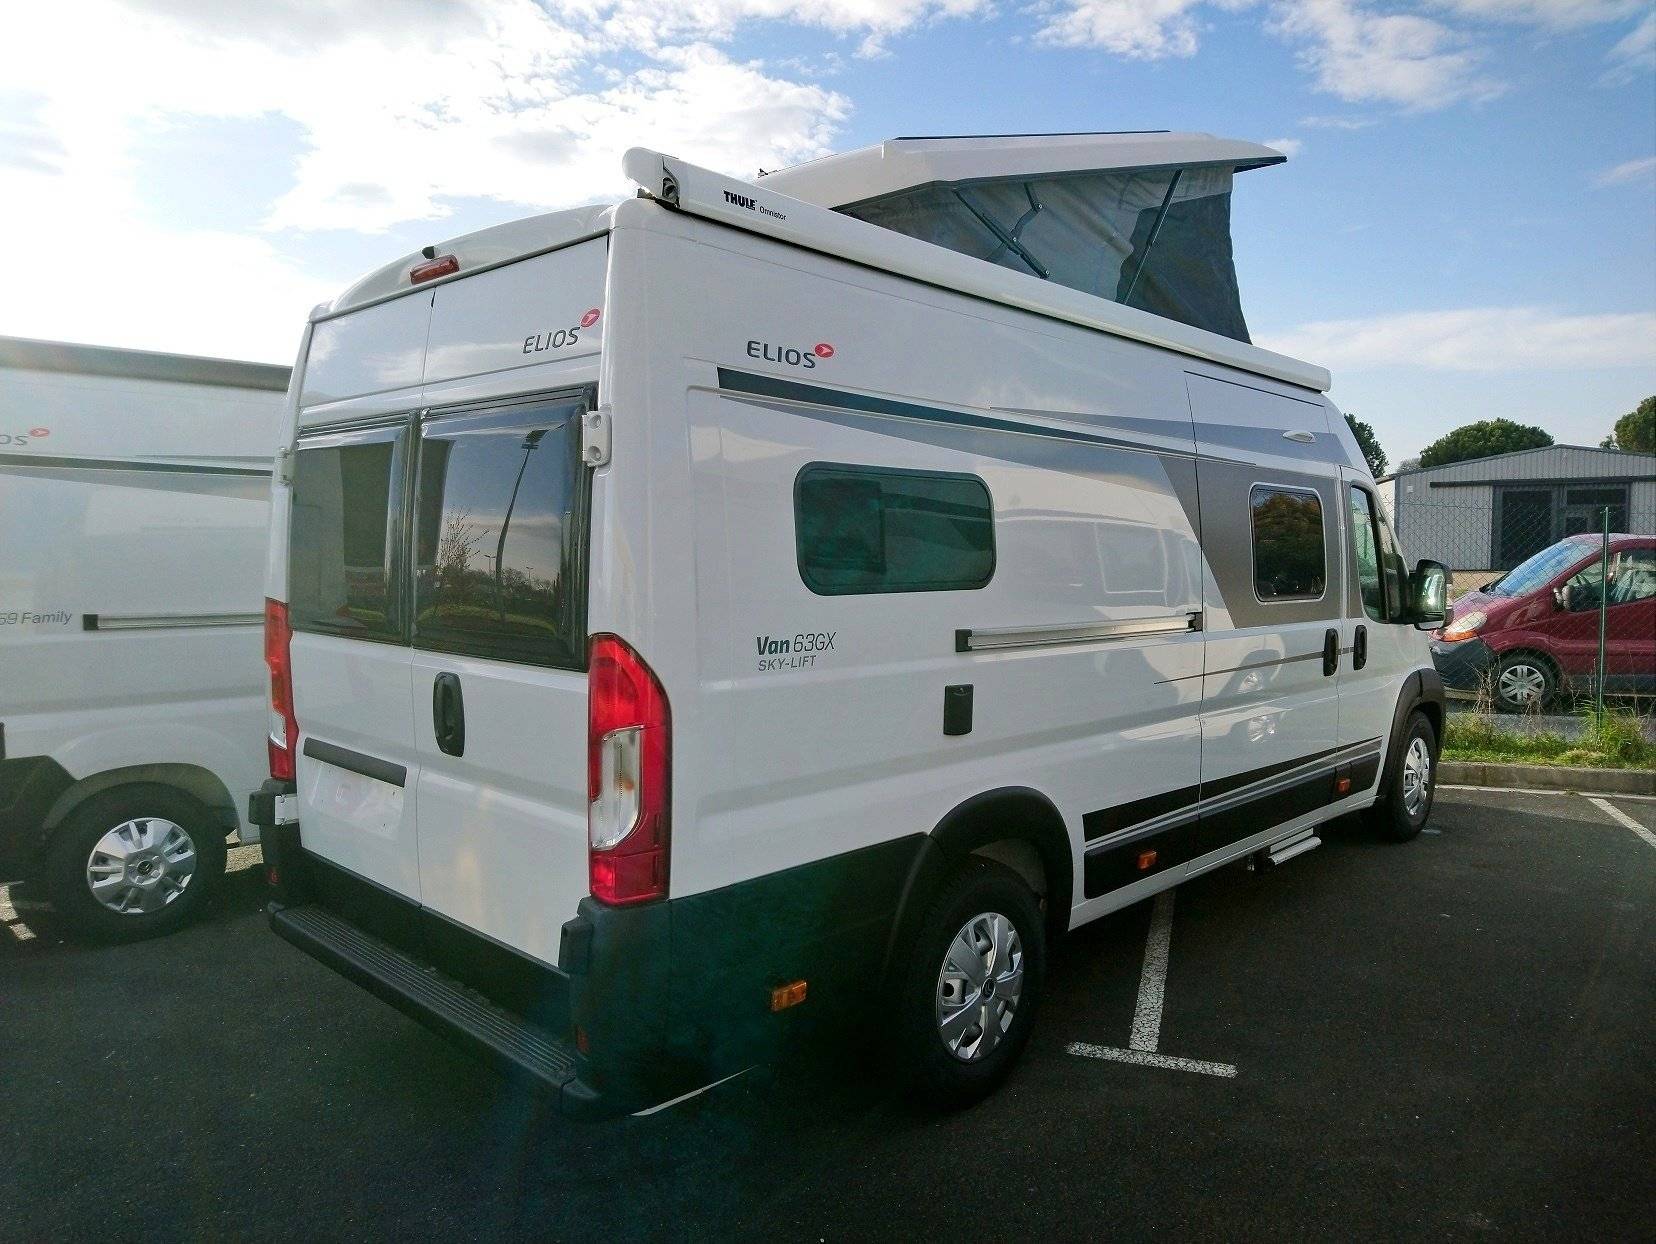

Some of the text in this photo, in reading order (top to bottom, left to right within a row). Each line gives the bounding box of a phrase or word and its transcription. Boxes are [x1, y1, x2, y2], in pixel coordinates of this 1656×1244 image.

[723, 190, 757, 211] THULE
[759, 205, 787, 221] Omnistor
[523, 326, 580, 354] ELIOS
[746, 340, 816, 369] ELIOS
[21, 610, 72, 625] Family
[756, 631, 837, 655] Van 63GX
[758, 655, 817, 671] SKY-LIFT
